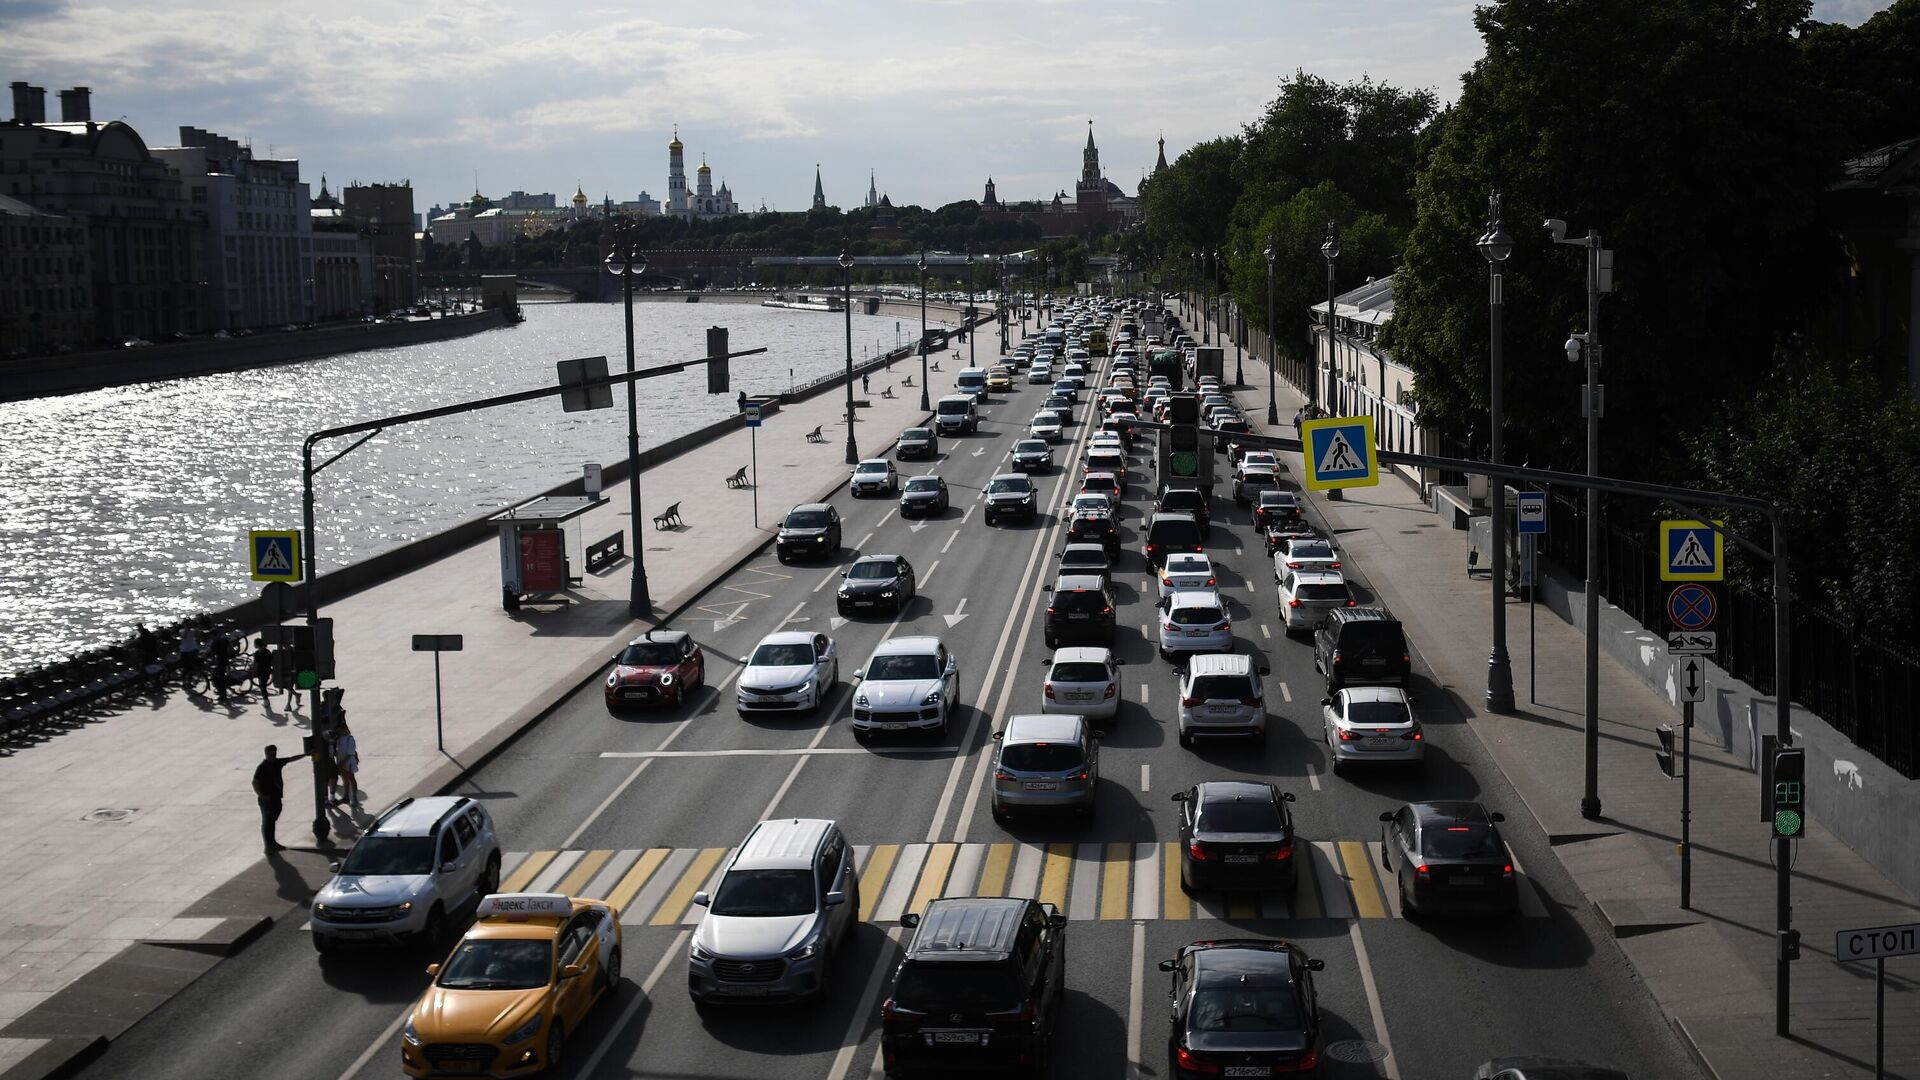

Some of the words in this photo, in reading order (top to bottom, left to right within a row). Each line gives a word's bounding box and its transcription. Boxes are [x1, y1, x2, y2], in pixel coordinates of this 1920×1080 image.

[492, 899, 525, 911] Яндекс
[528, 898, 553, 910] Такси
[1849, 930, 1914, 955] СТОП
